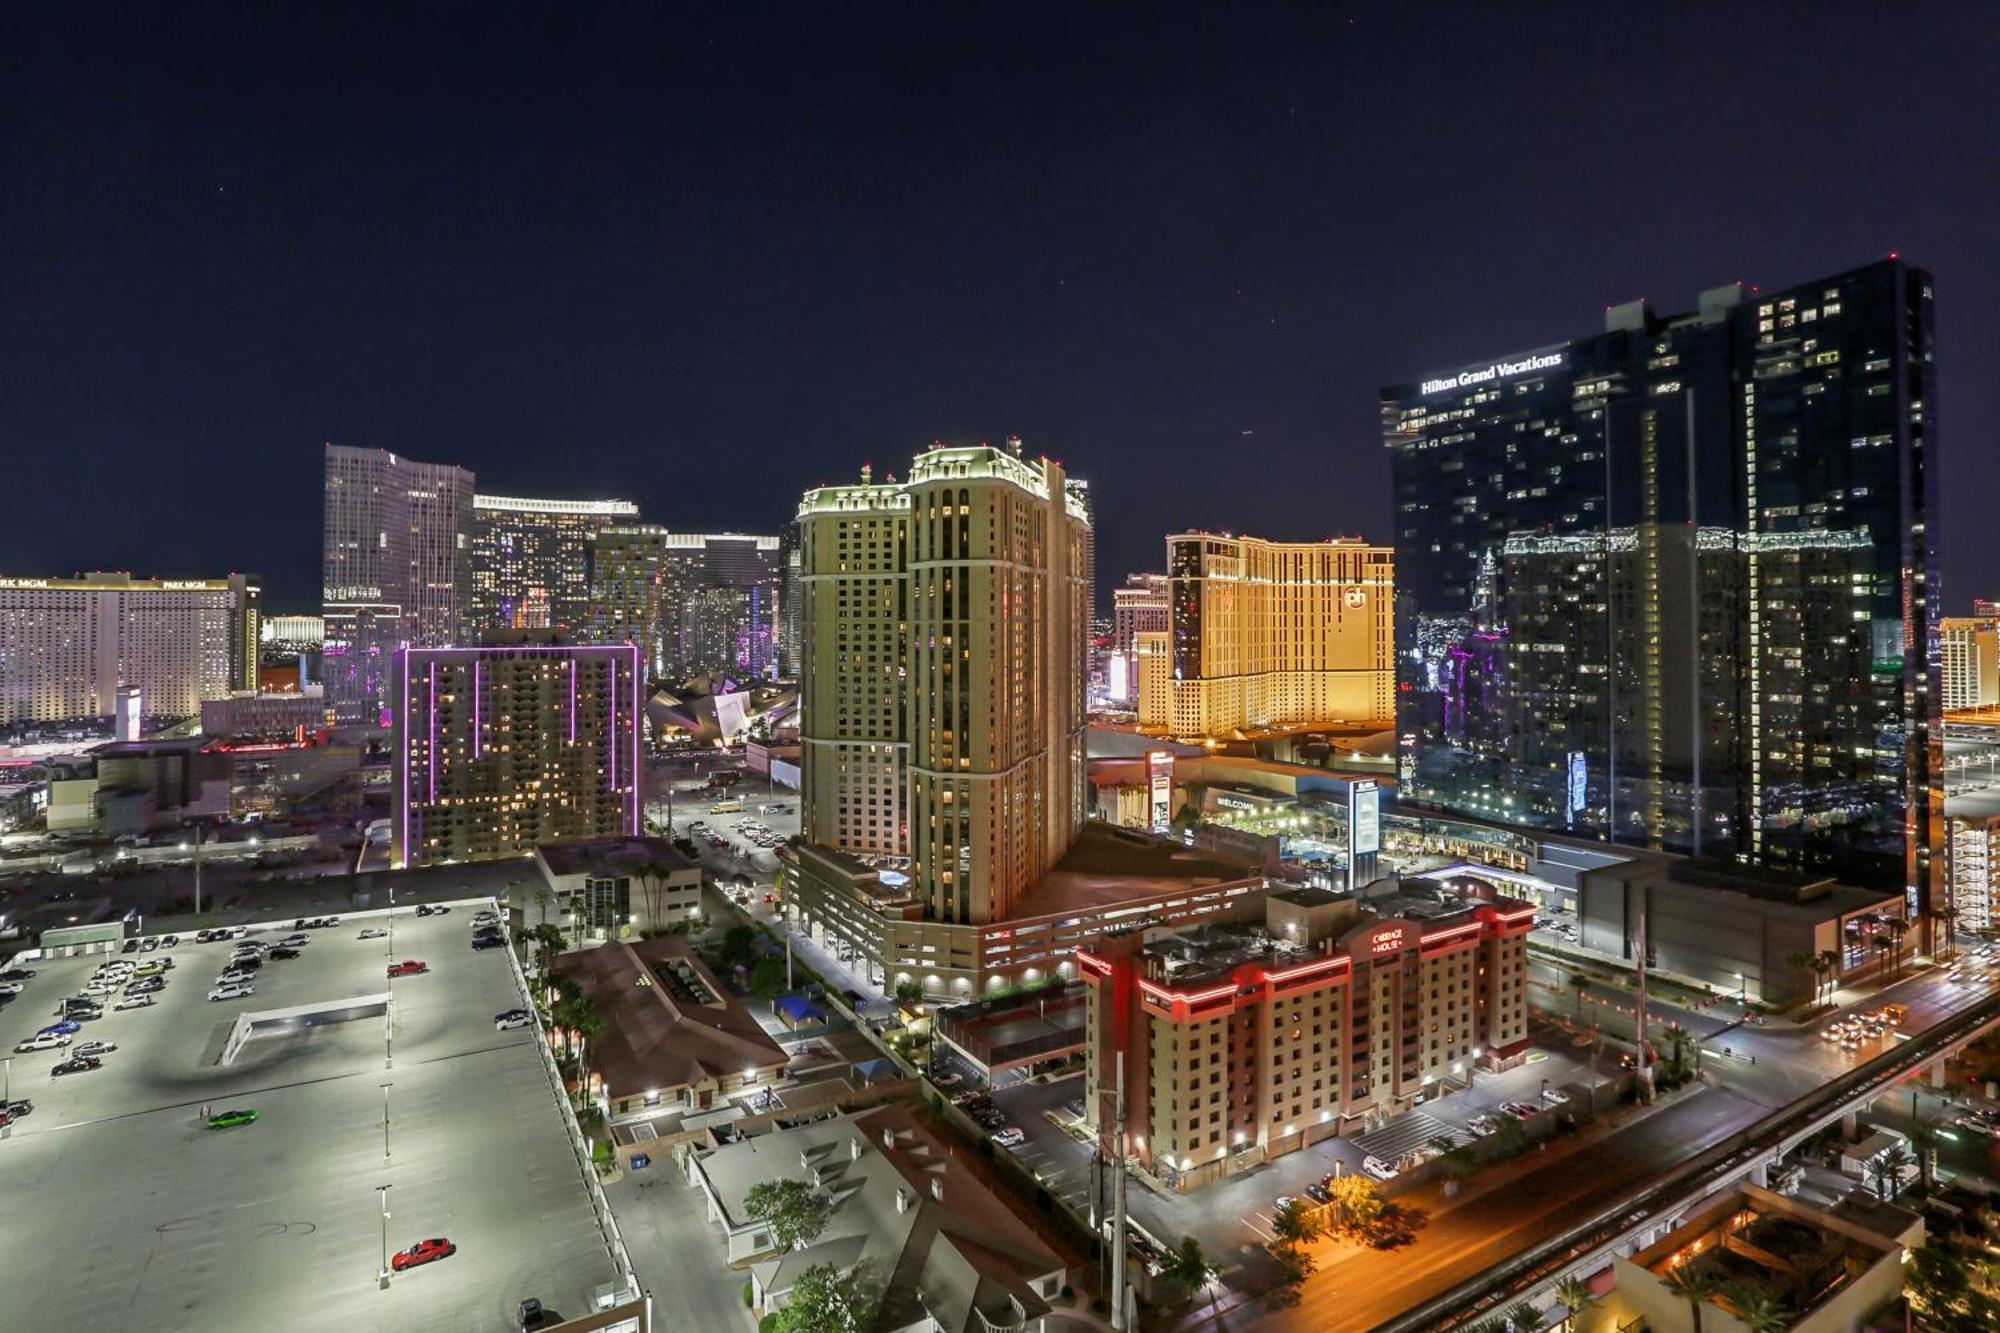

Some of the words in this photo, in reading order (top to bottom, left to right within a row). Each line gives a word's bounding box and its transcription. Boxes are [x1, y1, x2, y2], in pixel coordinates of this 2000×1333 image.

[1421, 378, 1457, 395] Hilton
[1458, 365, 1495, 387] Grand
[1497, 353, 1562, 377] Vacations
[18, 579, 48, 589] MGM
[163, 581, 184, 590] PARK
[185, 581, 206, 590] MGM
